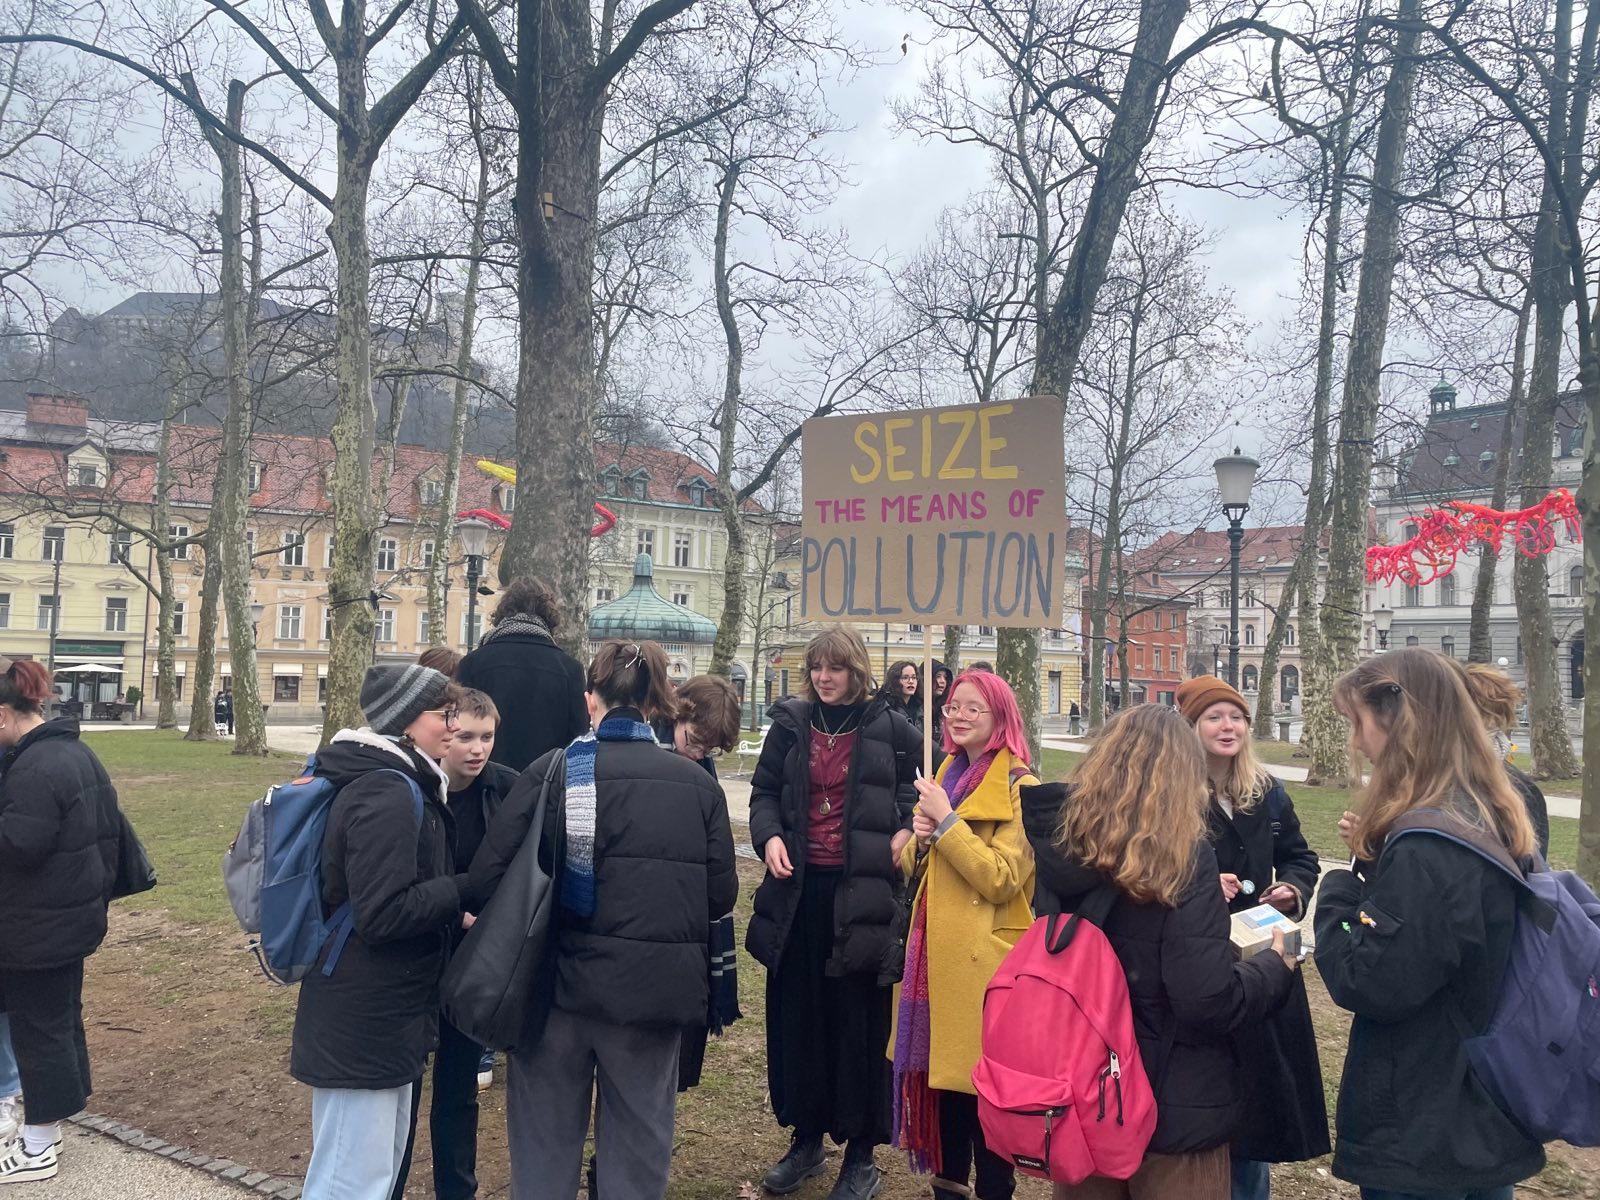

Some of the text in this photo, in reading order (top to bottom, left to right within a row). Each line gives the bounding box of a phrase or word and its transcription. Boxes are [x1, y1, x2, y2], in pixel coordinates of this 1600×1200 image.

[850, 404, 1018, 484] SEIZE
[815, 488, 1045, 523] THE MEANS OF
[801, 530, 1055, 619] POLLUTION
